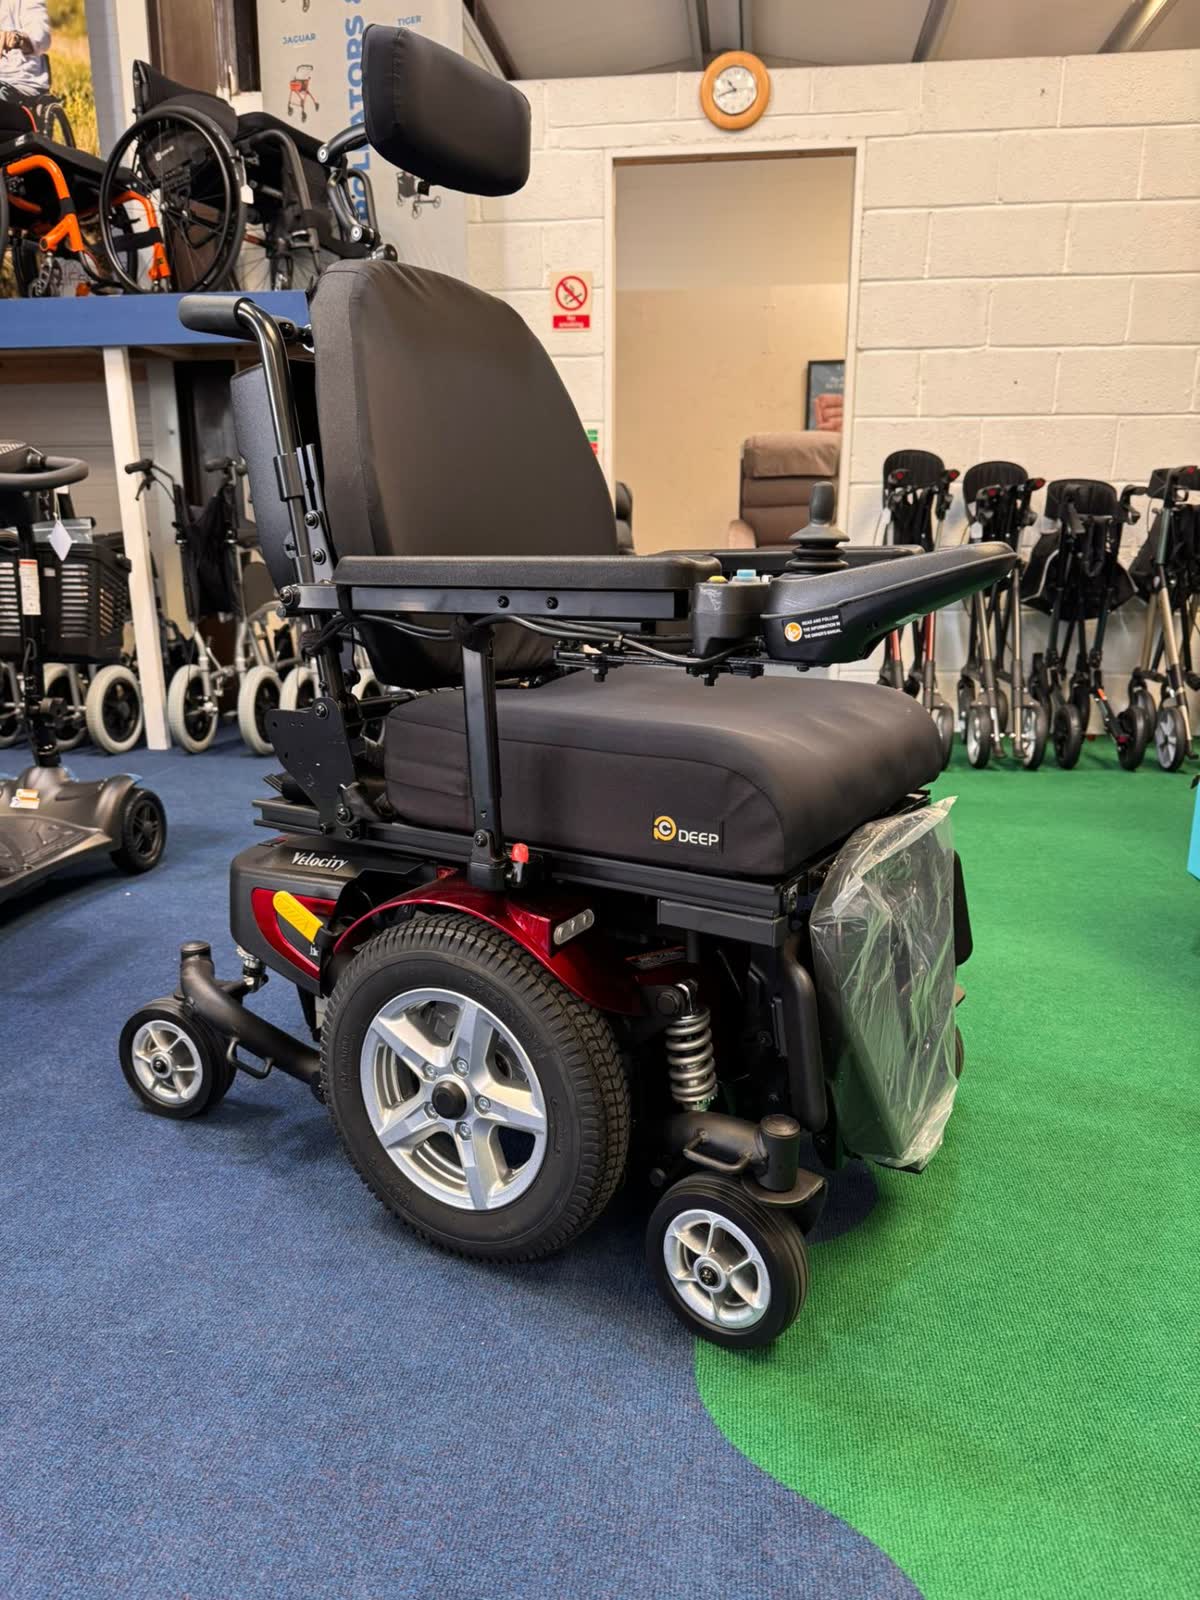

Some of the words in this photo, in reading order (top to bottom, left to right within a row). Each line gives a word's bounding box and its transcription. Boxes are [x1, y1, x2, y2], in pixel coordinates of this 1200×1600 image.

[397, 15, 422, 26] TIGER
[678, 829, 720, 847] DEEP
[291, 851, 349, 872] Velocity
